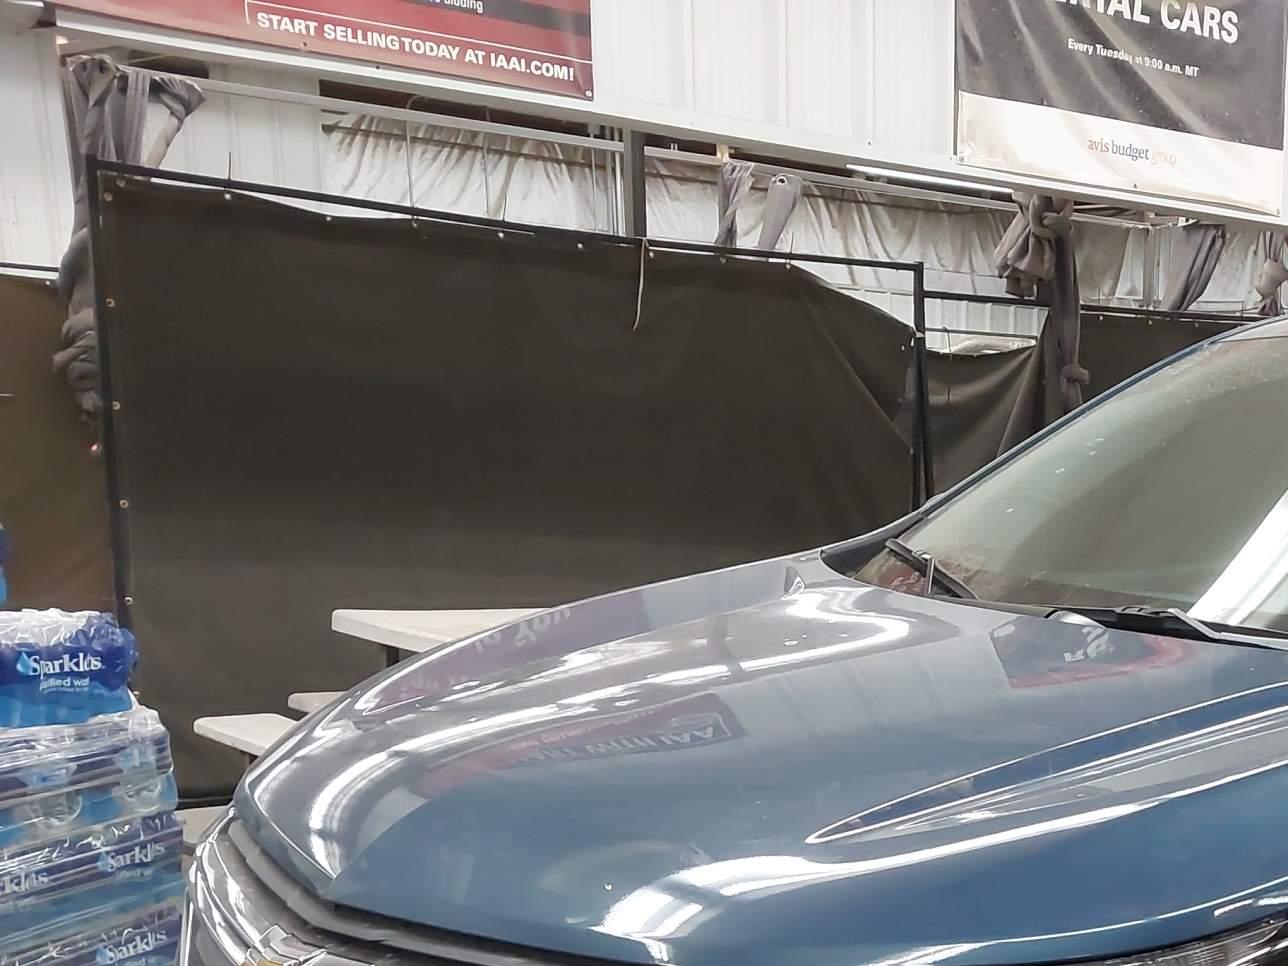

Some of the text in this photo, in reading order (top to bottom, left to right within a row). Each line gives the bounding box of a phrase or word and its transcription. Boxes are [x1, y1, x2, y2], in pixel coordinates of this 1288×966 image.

[1160, 0, 1239, 44] CARS
[256, 12, 574, 82] START SELLING TODAY AT IAAI.COM!
[1067, 38, 1094, 55] Every
[1095, 44, 1132, 64] Tuesday
[1144, 57, 1163, 70] 9:00
[1164, 63, 1183, 74] a.m.
[1184, 65, 1200, 77] MT
[1087, 137, 1110, 153] avis
[1111, 140, 1150, 161] budget
